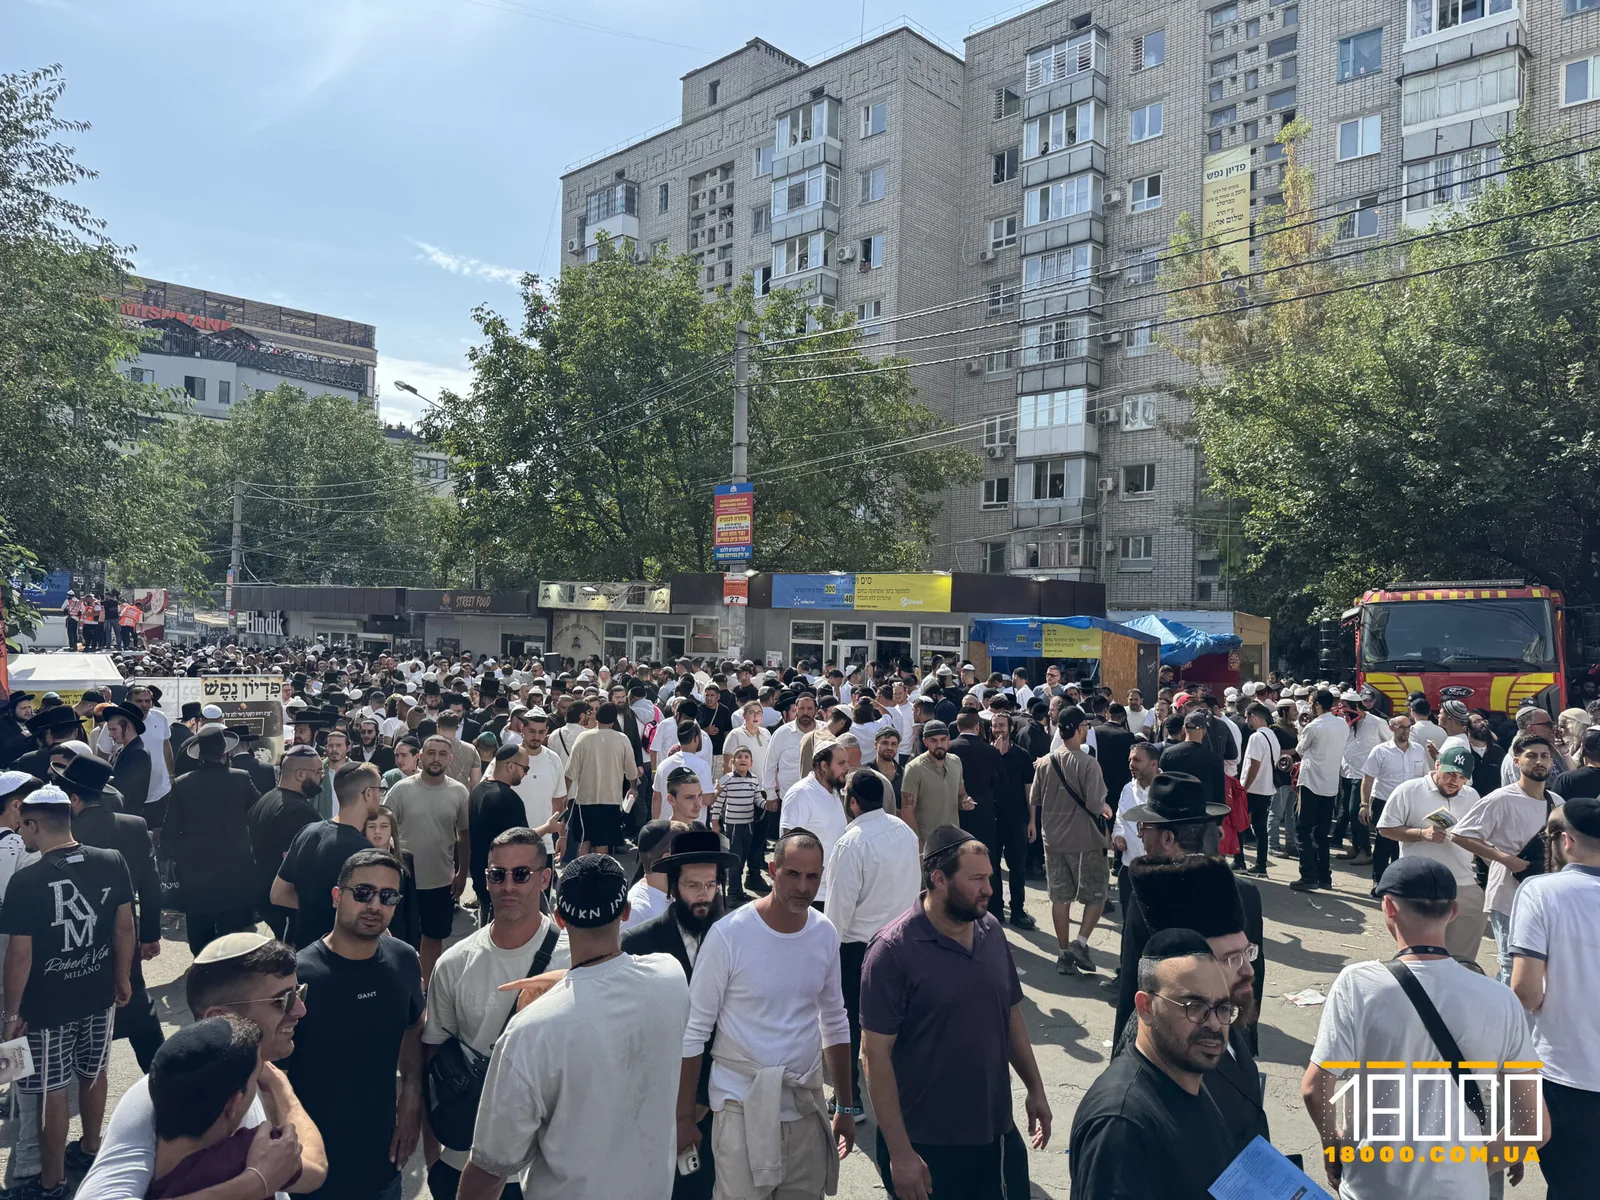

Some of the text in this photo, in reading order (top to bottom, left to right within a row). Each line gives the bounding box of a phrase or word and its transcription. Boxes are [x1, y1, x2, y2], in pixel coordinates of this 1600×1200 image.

[1206, 163, 1246, 180] פדיון נפש
[456, 596, 476, 608] STREET
[476, 595, 491, 608] FOOD
[845, 595, 853, 603] 40
[246, 610, 284, 636] Hindik
[1446, 688, 1468, 696] Ford
[44, 952, 91, 976] Roberto
[63, 963, 101, 980] MILANO
[357, 991, 377, 1000] GANT
